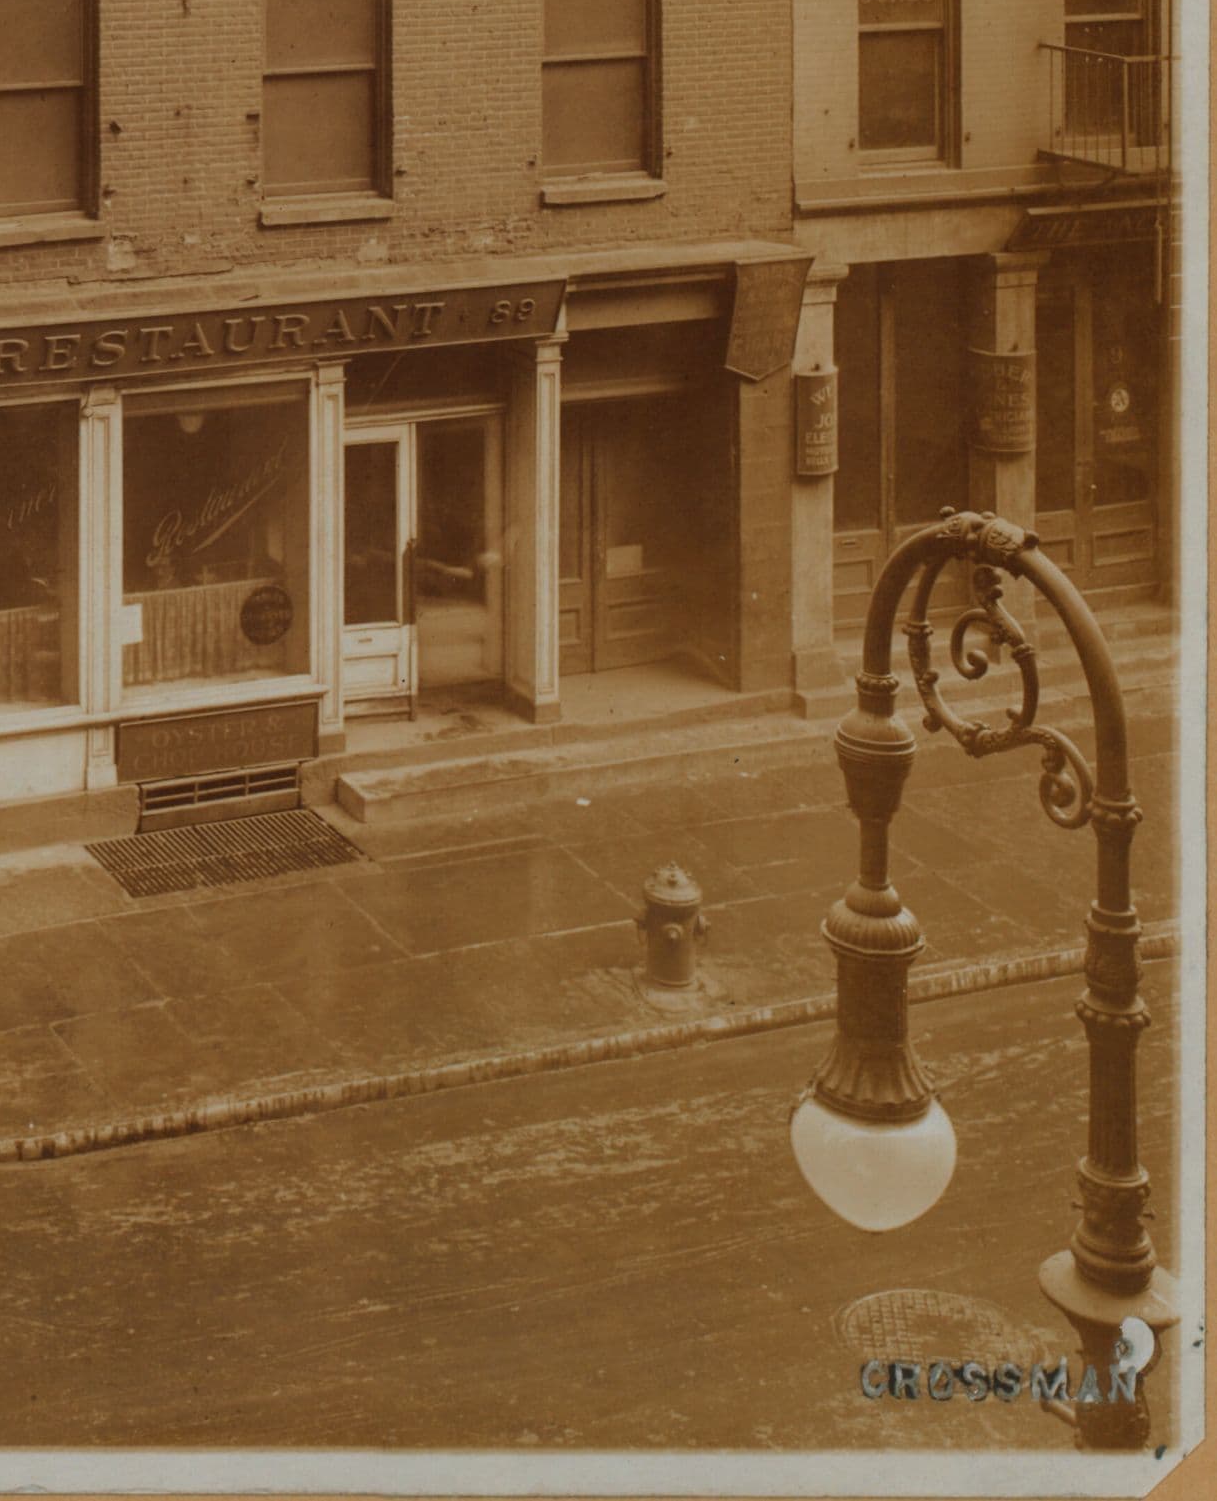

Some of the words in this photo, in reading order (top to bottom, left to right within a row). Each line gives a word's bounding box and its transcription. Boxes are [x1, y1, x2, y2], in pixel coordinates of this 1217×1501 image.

[487, 296, 538, 325] 89
[145, 435, 289, 568] Restaurant
[151, 714, 257, 749] OYSTER
[265, 713, 285, 733] &
[133, 745, 206, 772] CHOP
[213, 733, 303, 762] HOUSE
